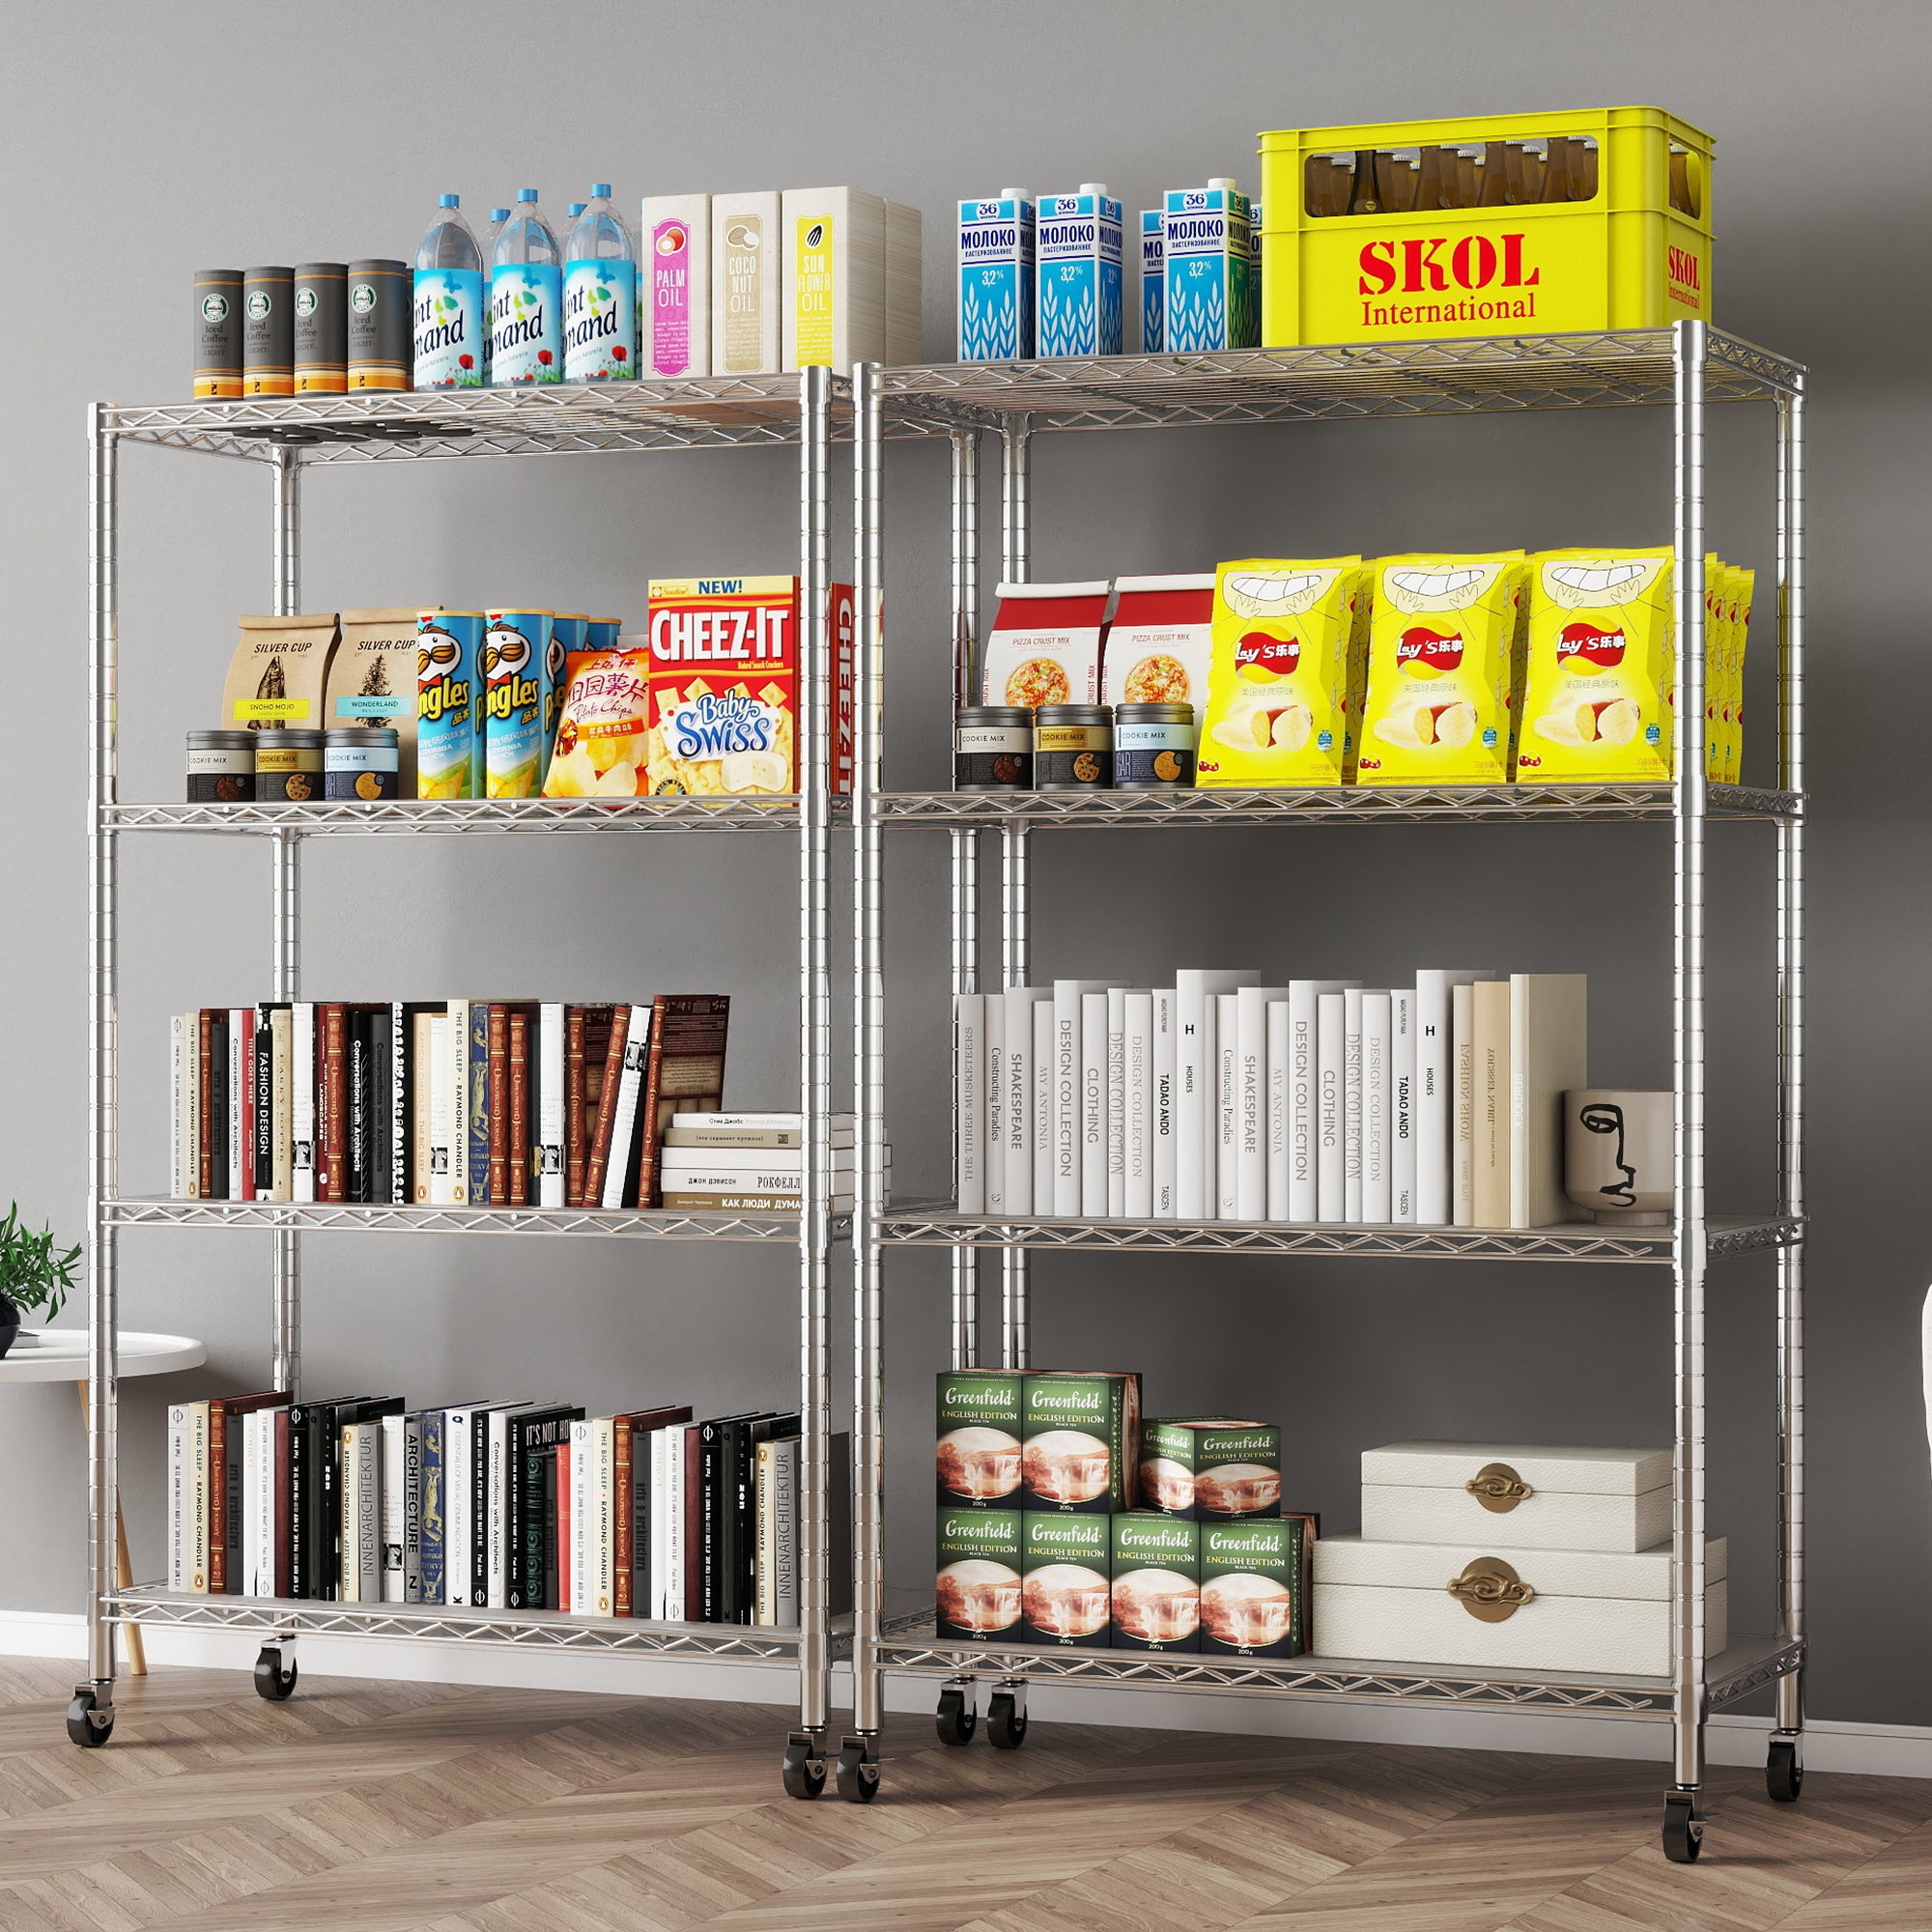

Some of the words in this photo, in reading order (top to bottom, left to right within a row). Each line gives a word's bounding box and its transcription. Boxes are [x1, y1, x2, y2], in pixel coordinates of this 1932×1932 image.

[979, 203, 998, 215] 36
[1058, 199, 1076, 211] 36
[1186, 193, 1205, 205] 36
[961, 228, 1015, 249] МОЛОКО
[1039, 224, 1094, 245] МОЛОКО
[1168, 219, 1223, 241] МОЛОКО
[729, 256, 755, 275] COCO
[804, 254, 825, 273] SUN
[1359, 233, 1539, 296] SKOL
[1668, 244, 1700, 292] SKOL
[656, 270, 685, 287] PALM
[732, 275, 753, 293] NUT
[798, 273, 830, 292] FLOWER
[658, 289, 683, 307] OIL
[730, 295, 754, 313] OIL
[802, 293, 827, 311] OIL
[1668, 281, 1700, 309] International
[1361, 293, 1536, 326] International
[201, 334, 229, 343] Coffee
[205, 325, 223, 333] Iced
[698, 580, 742, 595] NEW!
[651, 607, 788, 661] CHEEZ-IT
[254, 643, 289, 654] SILVER
[291, 642, 313, 653] CUP
[357, 640, 392, 651] SILVER
[394, 639, 415, 650] CUP
[696, 689, 760, 725] Baby
[1061, 1020, 1071, 1075] DESIGN
[1110, 1032, 1122, 1084] DESIGN
[1295, 1021, 1307, 1078] DESIGN
[964, 1027, 973, 1109] MUSKETEERS
[1370, 1037, 1380, 1090] DESIGN
[260, 1052, 269, 1106] FASHION
[989, 1047, 1001, 1102] Constructing
[1039, 1066, 1047, 1085] MY
[1160, 1074, 1169, 1106] TADAO
[1399, 1076, 1408, 1109] TADAO
[1011, 1053, 1022, 1150] SHAKESPEARE
[1088, 1068, 1098, 1143] CLOTHING
[1323, 1070, 1335, 1147] CLOTHING
[991, 1105, 1001, 1141] Paradies
[1061, 1080, 1071, 1177] COLLECTION
[1110, 1089, 1122, 1175] COLLECTION
[1160, 1108, 1169, 1135] ANDO
[1295, 1083, 1307, 1180] COLLECTION
[1399, 1111, 1408, 1139] ANDO
[260, 1110, 269, 1155] DESIGN
[964, 1112, 973, 1153] THREE
[1370, 1094, 1380, 1182] COLLECTION
[964, 1156, 973, 1181] THE
[722, 1199, 740, 1208] КАК
[742, 1199, 771, 1208] ЛЮДИ
[774, 1199, 801, 1209] ДУМА
[945, 1387, 1012, 1406] Greenfield
[1032, 1390, 1100, 1410] Greenfield
[942, 1410, 978, 1419] ENGLISH
[979, 1410, 1017, 1420] EDITION
[1028, 1413, 1065, 1422] ENGLISH
[1065, 1414, 1104, 1424] EDITION
[542, 1423, 555, 1443] NOT
[1146, 1430, 1188, 1448] Greenfield
[1203, 1435, 1272, 1451] Greenfield
[408, 1435, 418, 1553] ARCHITECTURE
[360, 1436, 374, 1576] INNENARCHITEKTUR
[776, 1454, 792, 1599] INNENARCHITEKTUR
[945, 1520, 1012, 1539] Greenfield
[1032, 1523, 1100, 1544] Greenfield
[1121, 1528, 1190, 1548] Greenfield
[1209, 1532, 1281, 1552] Greenfield
[1117, 1551, 1155, 1560] ENGLISH
[1156, 1552, 1195, 1562] EDITION
[1246, 1557, 1285, 1567] EDITION
